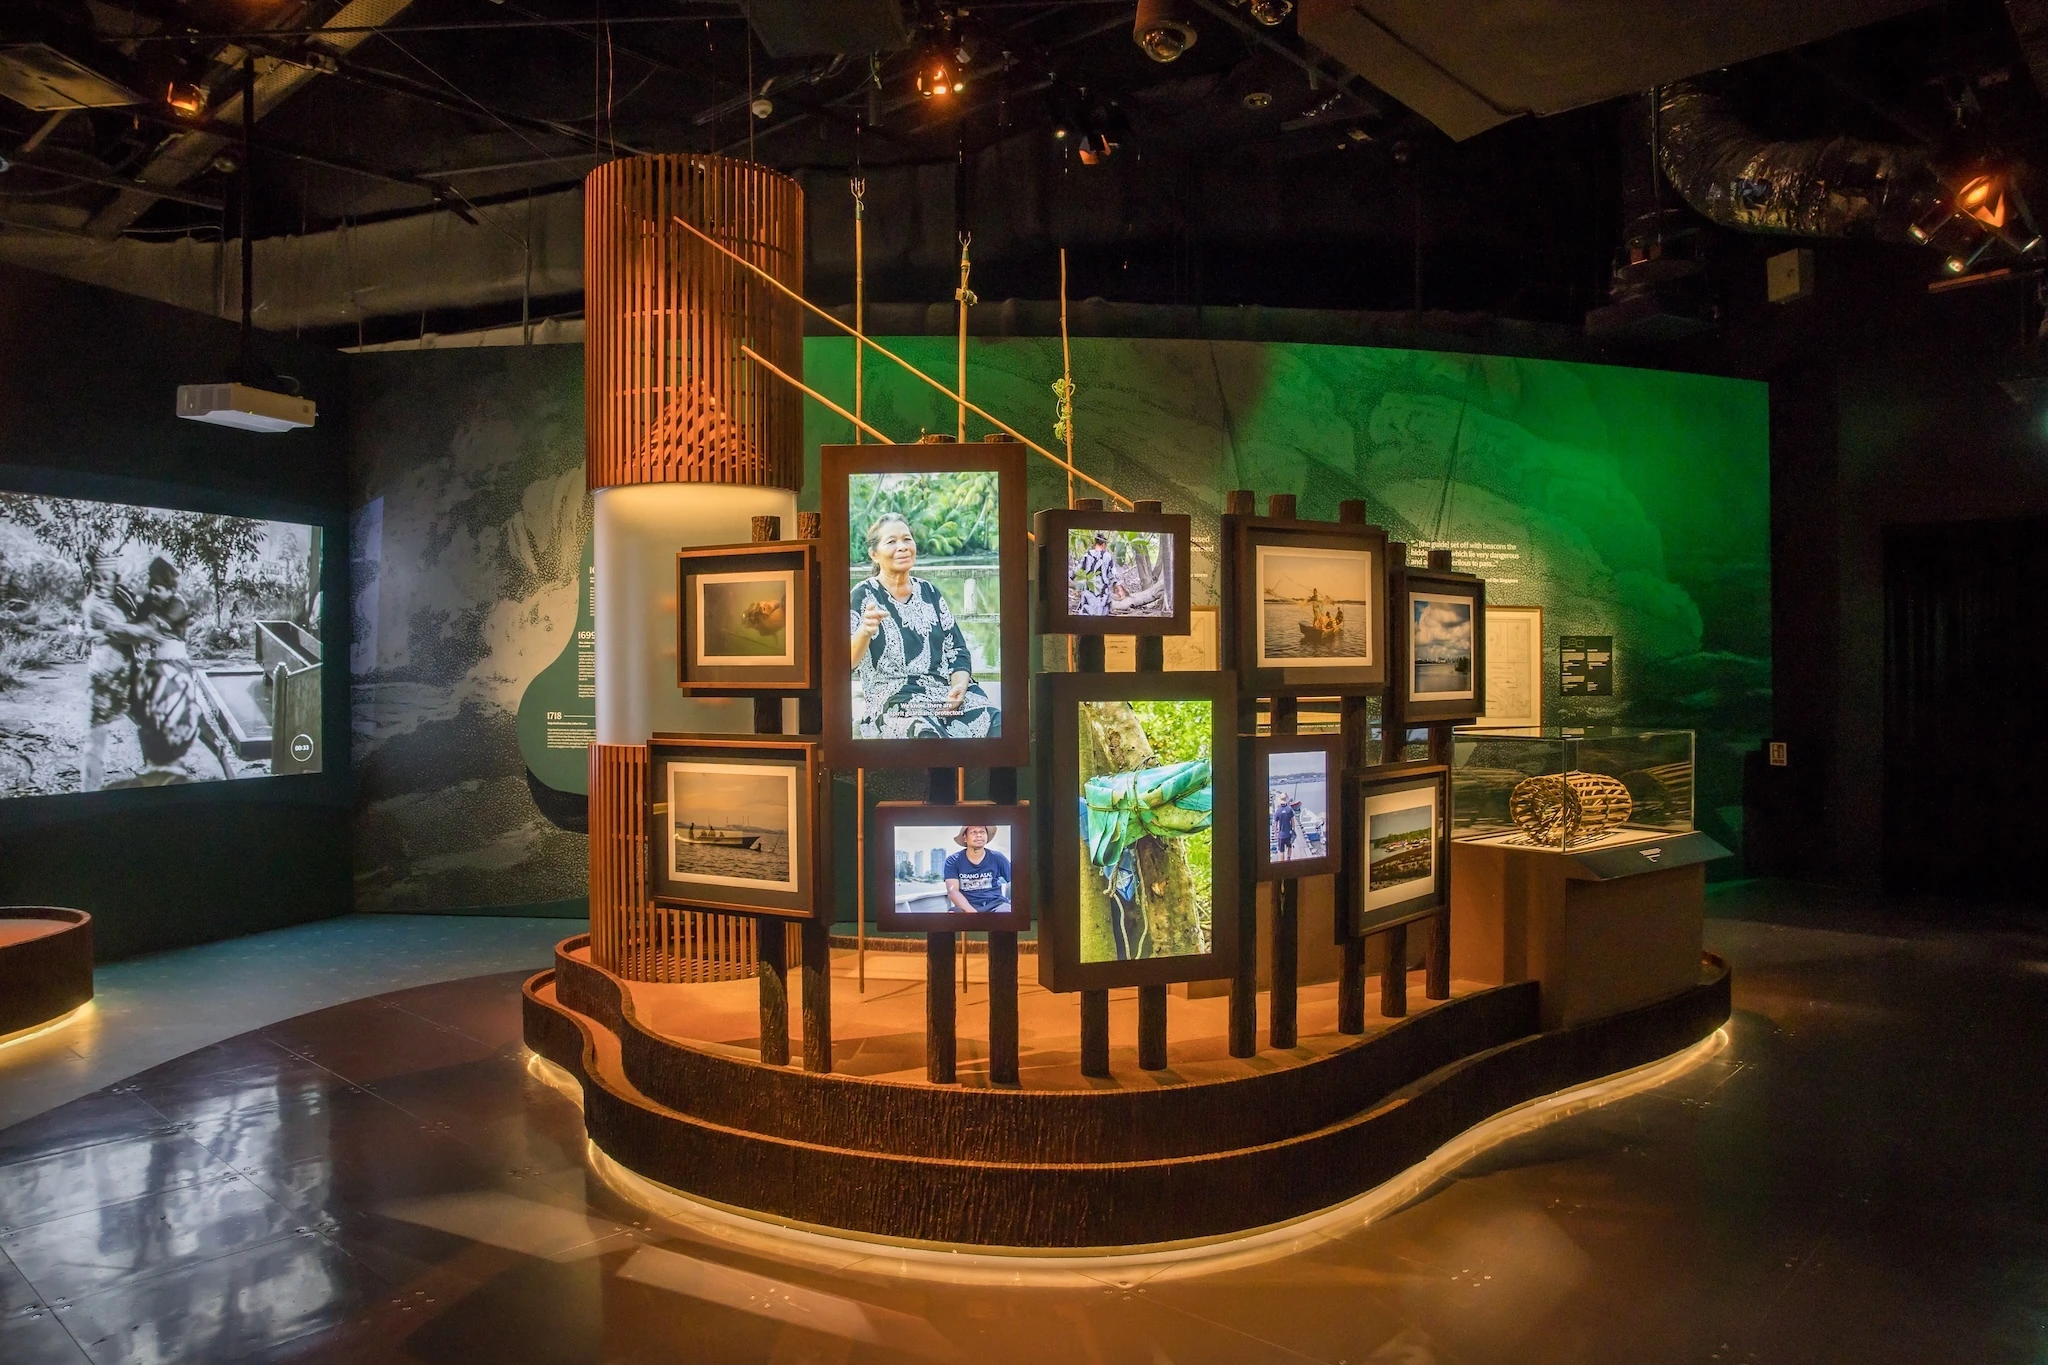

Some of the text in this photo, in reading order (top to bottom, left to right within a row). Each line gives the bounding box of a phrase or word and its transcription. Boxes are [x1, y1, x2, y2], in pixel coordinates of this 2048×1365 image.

[1476, 552, 1490, 560] very
[1490, 552, 1520, 561] dangerous
[1411, 558, 1422, 566] and
[1451, 559, 1471, 567] erilous
[547, 711, 562, 720] 1718
